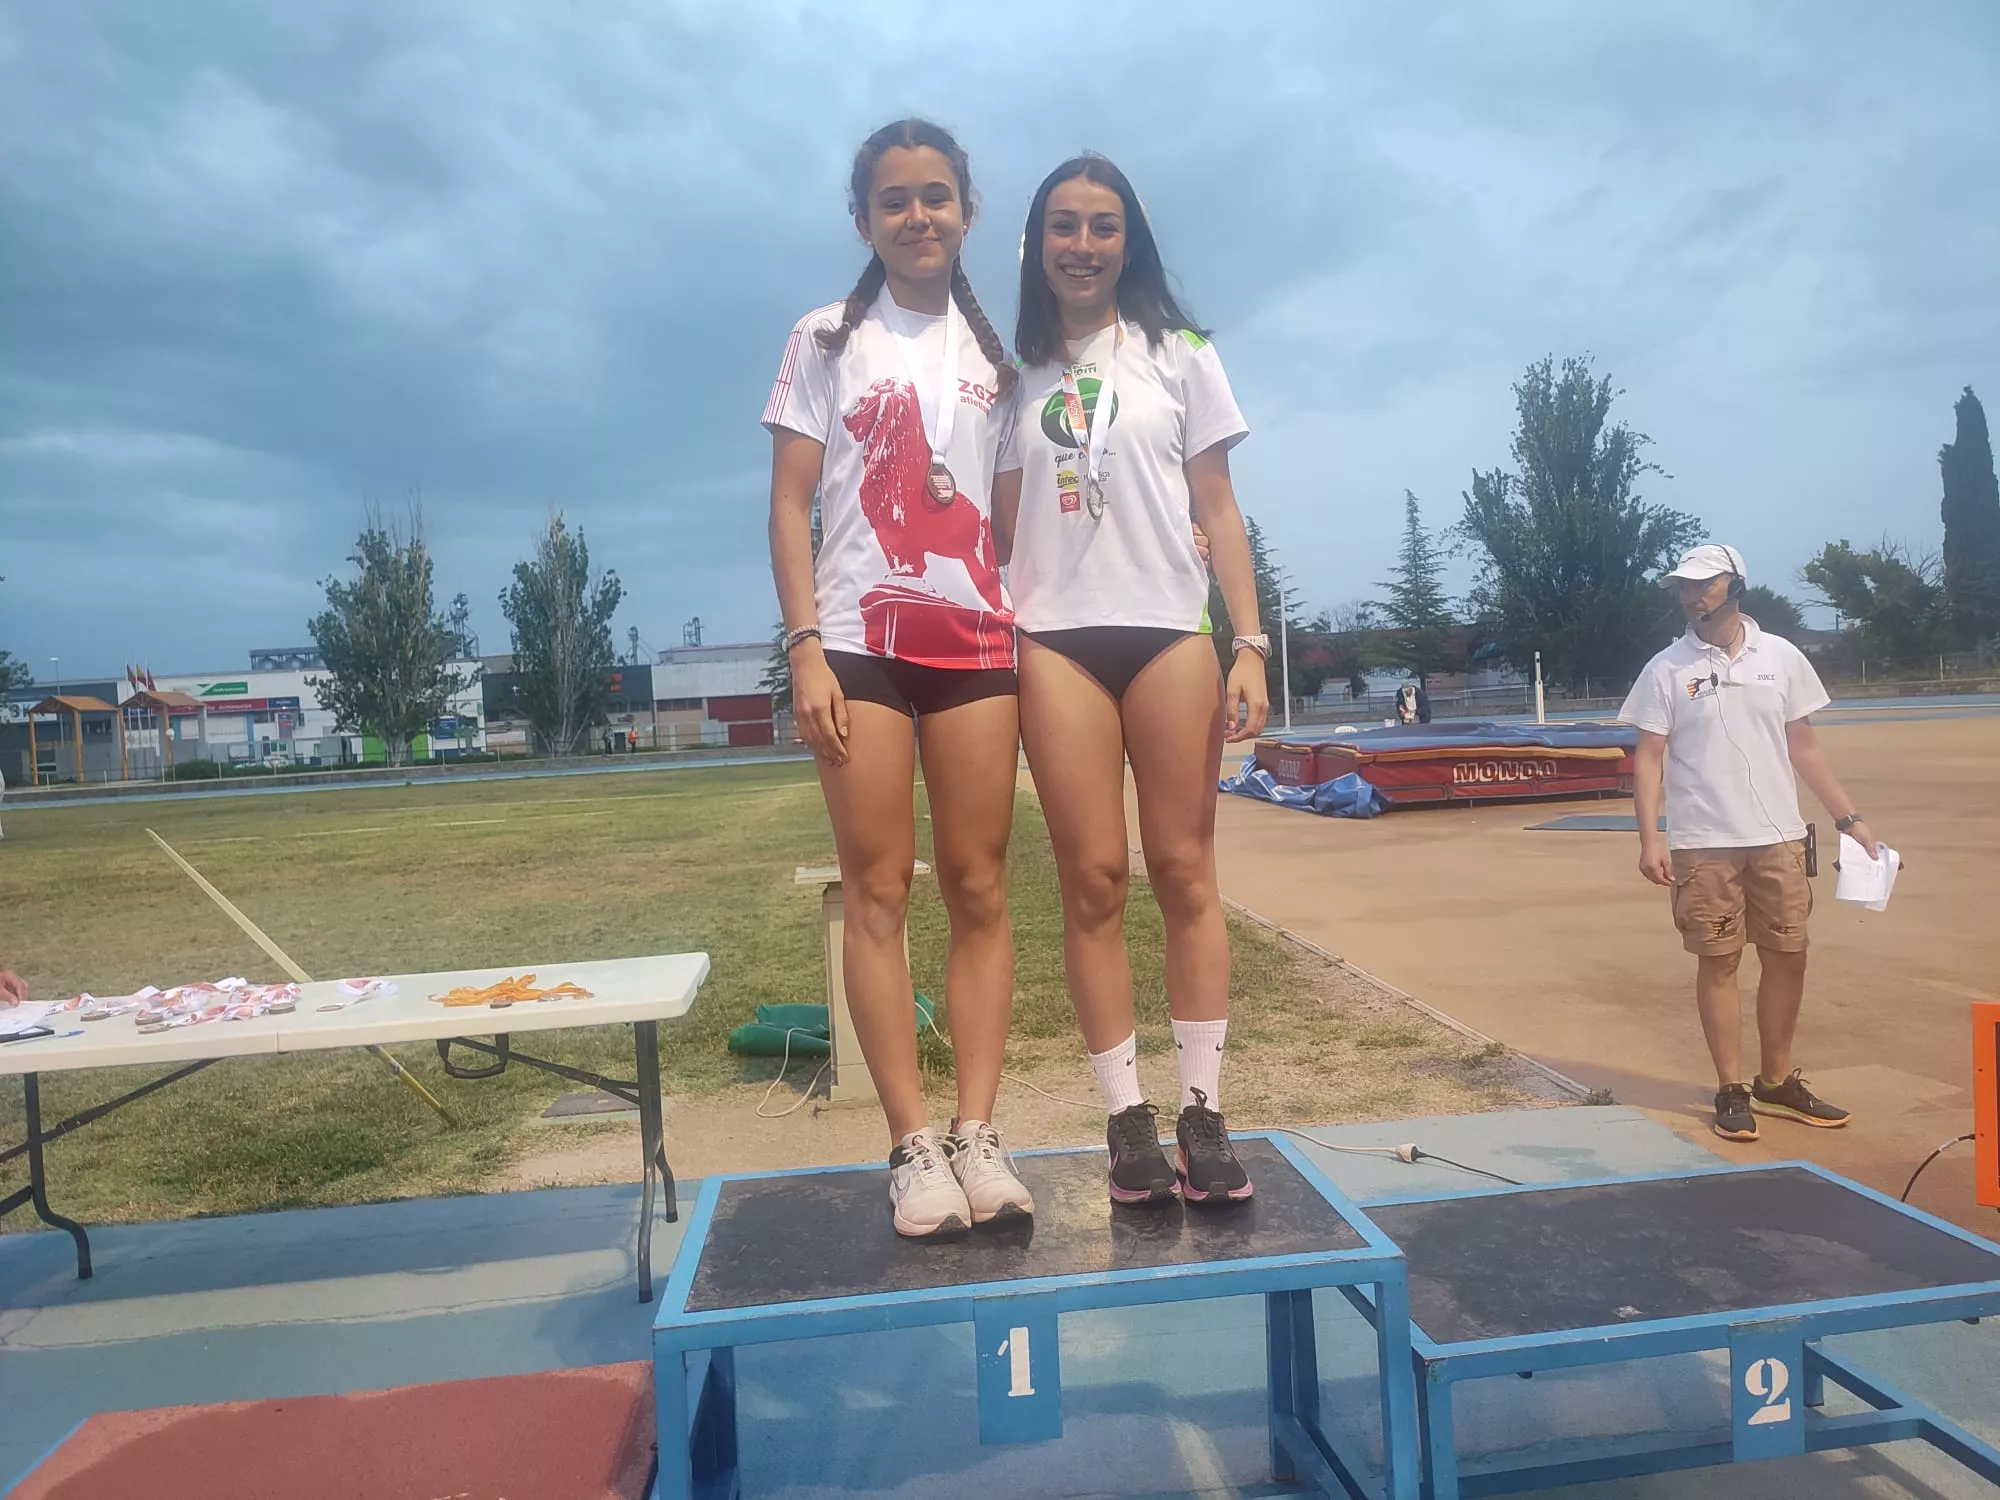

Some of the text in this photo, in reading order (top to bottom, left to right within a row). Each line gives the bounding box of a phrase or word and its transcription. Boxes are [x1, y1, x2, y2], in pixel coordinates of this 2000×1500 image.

[957, 378, 997, 406] ZGZ
[1054, 452, 1075, 468] que
[1056, 473, 1080, 486] intec
[1453, 759, 1557, 784] MONDO
[997, 1326, 1036, 1397] 1
[1744, 1357, 1791, 1425] 2
